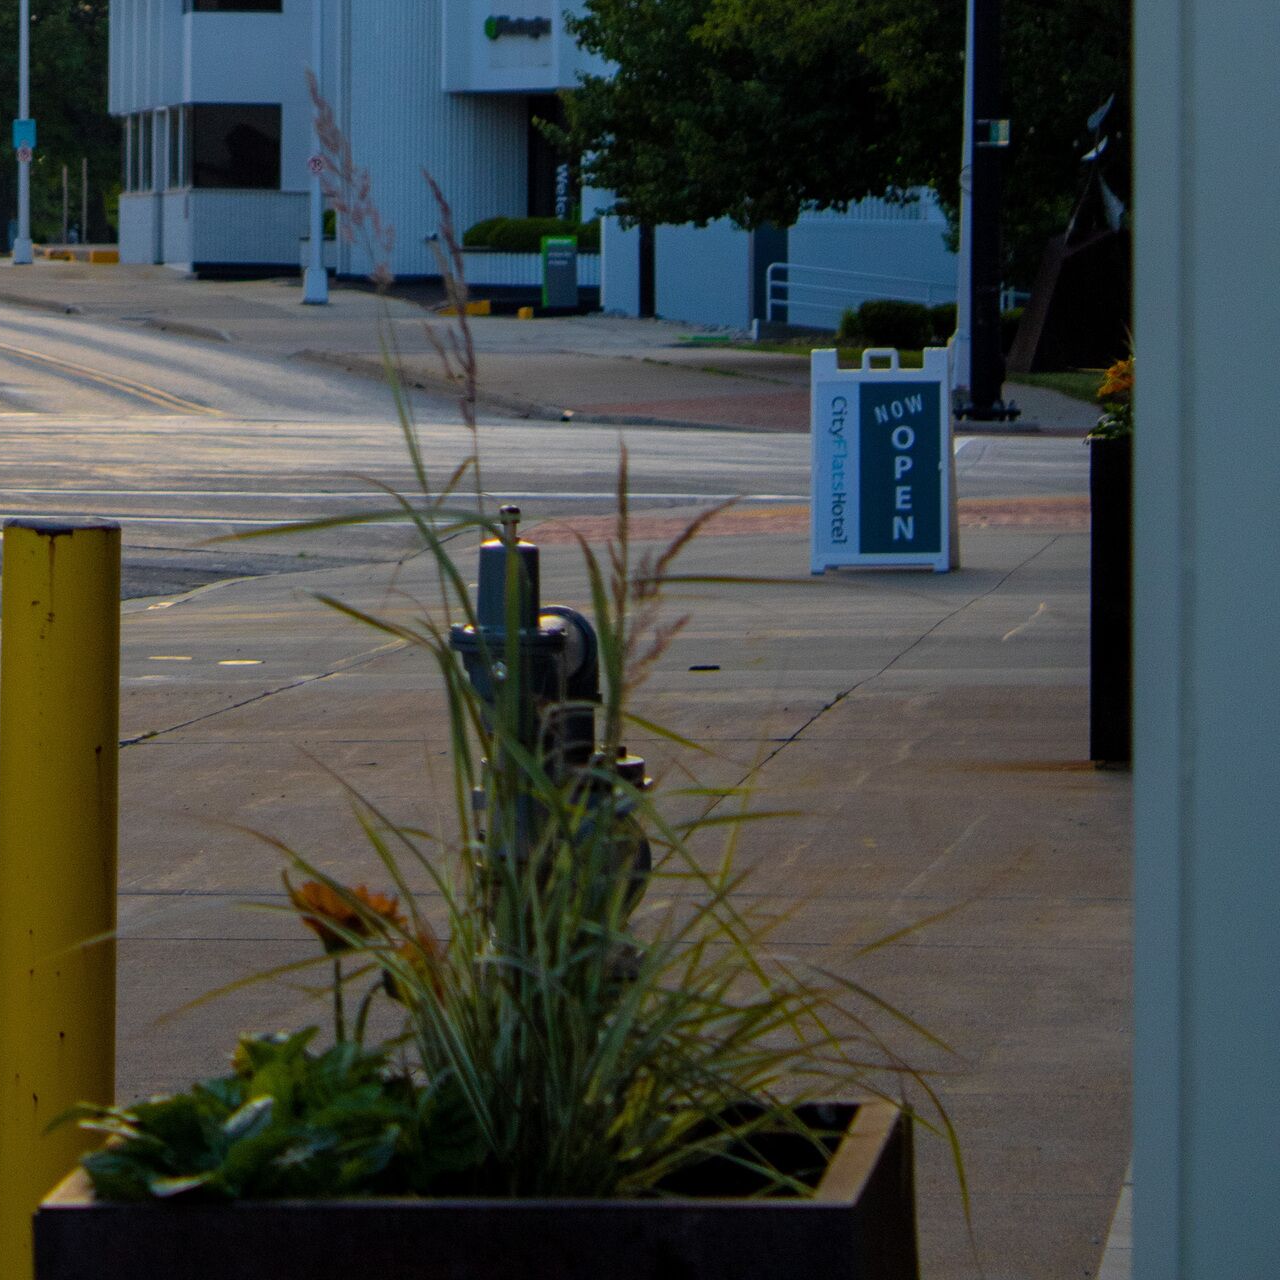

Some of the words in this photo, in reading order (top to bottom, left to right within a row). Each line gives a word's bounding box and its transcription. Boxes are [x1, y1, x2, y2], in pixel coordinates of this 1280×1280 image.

[874, 393, 923, 424] NOW
[828, 395, 848, 545] CityFlatsHotel
[891, 425, 916, 542] OPEN
